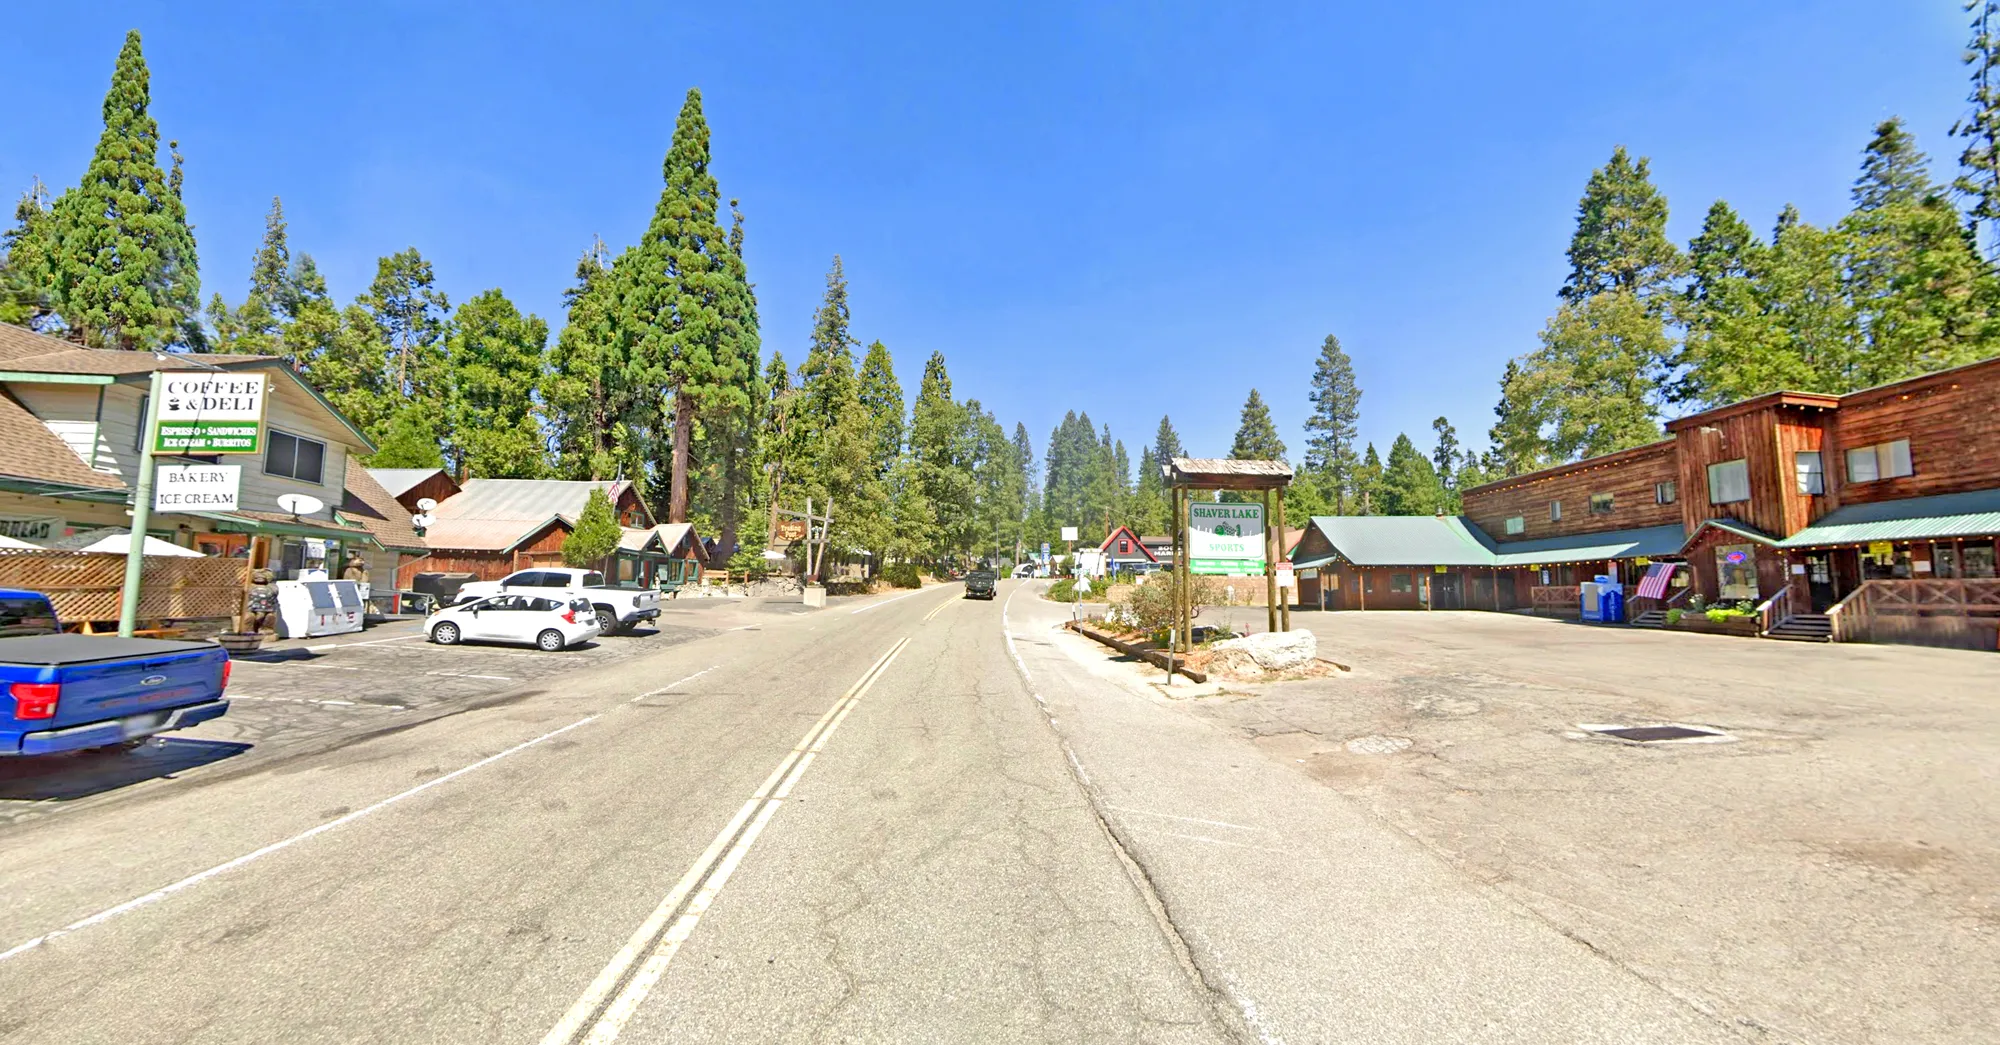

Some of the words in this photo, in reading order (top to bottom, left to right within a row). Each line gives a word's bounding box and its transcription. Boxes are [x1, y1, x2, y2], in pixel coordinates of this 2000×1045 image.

[168, 381, 259, 394] COFFEE
[186, 398, 198, 410] &
[204, 397, 254, 411] DELI
[161, 426, 200, 435] ESPRESSO
[207, 427, 256, 435] SANDWICHES
[163, 438, 178, 447] ICE
[179, 438, 205, 447] CREAM
[212, 438, 251, 447] BURRITOS
[169, 472, 228, 483] BAKERY
[160, 494, 182, 504] ICE
[184, 493, 233, 504] CREAM
[1193, 508, 1231, 518] SHAVER
[1232, 509, 1260, 519] LAKE
[1209, 543, 1244, 552] SPORTS
